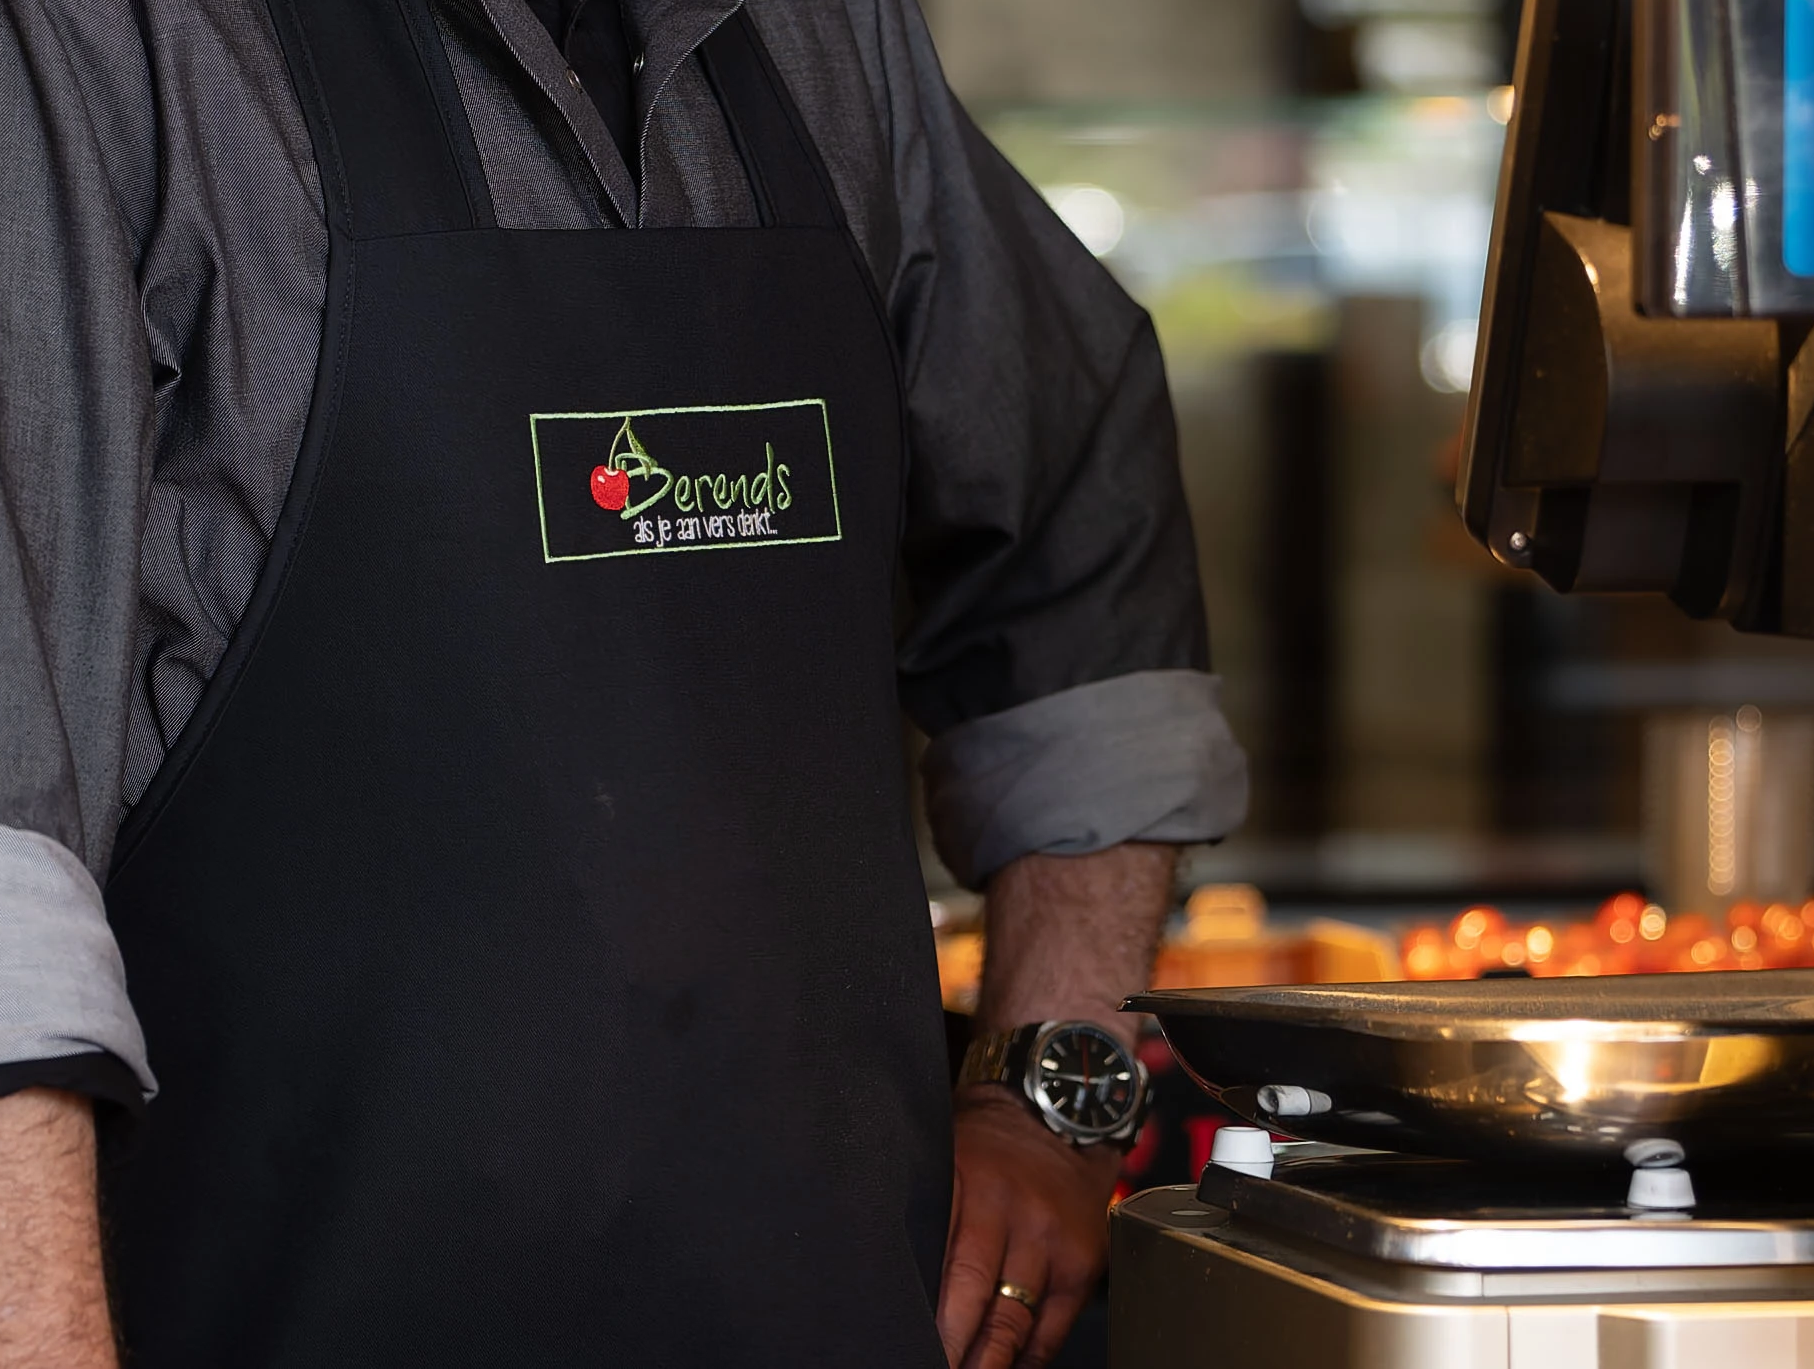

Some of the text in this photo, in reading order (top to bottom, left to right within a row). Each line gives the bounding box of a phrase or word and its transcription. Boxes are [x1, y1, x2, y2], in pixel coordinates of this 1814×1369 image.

[616, 442, 792, 519] Berends
[633, 516, 654, 543] als
[656, 516, 672, 547] je
[677, 518, 701, 540] aan
[704, 512, 735, 538] vers
